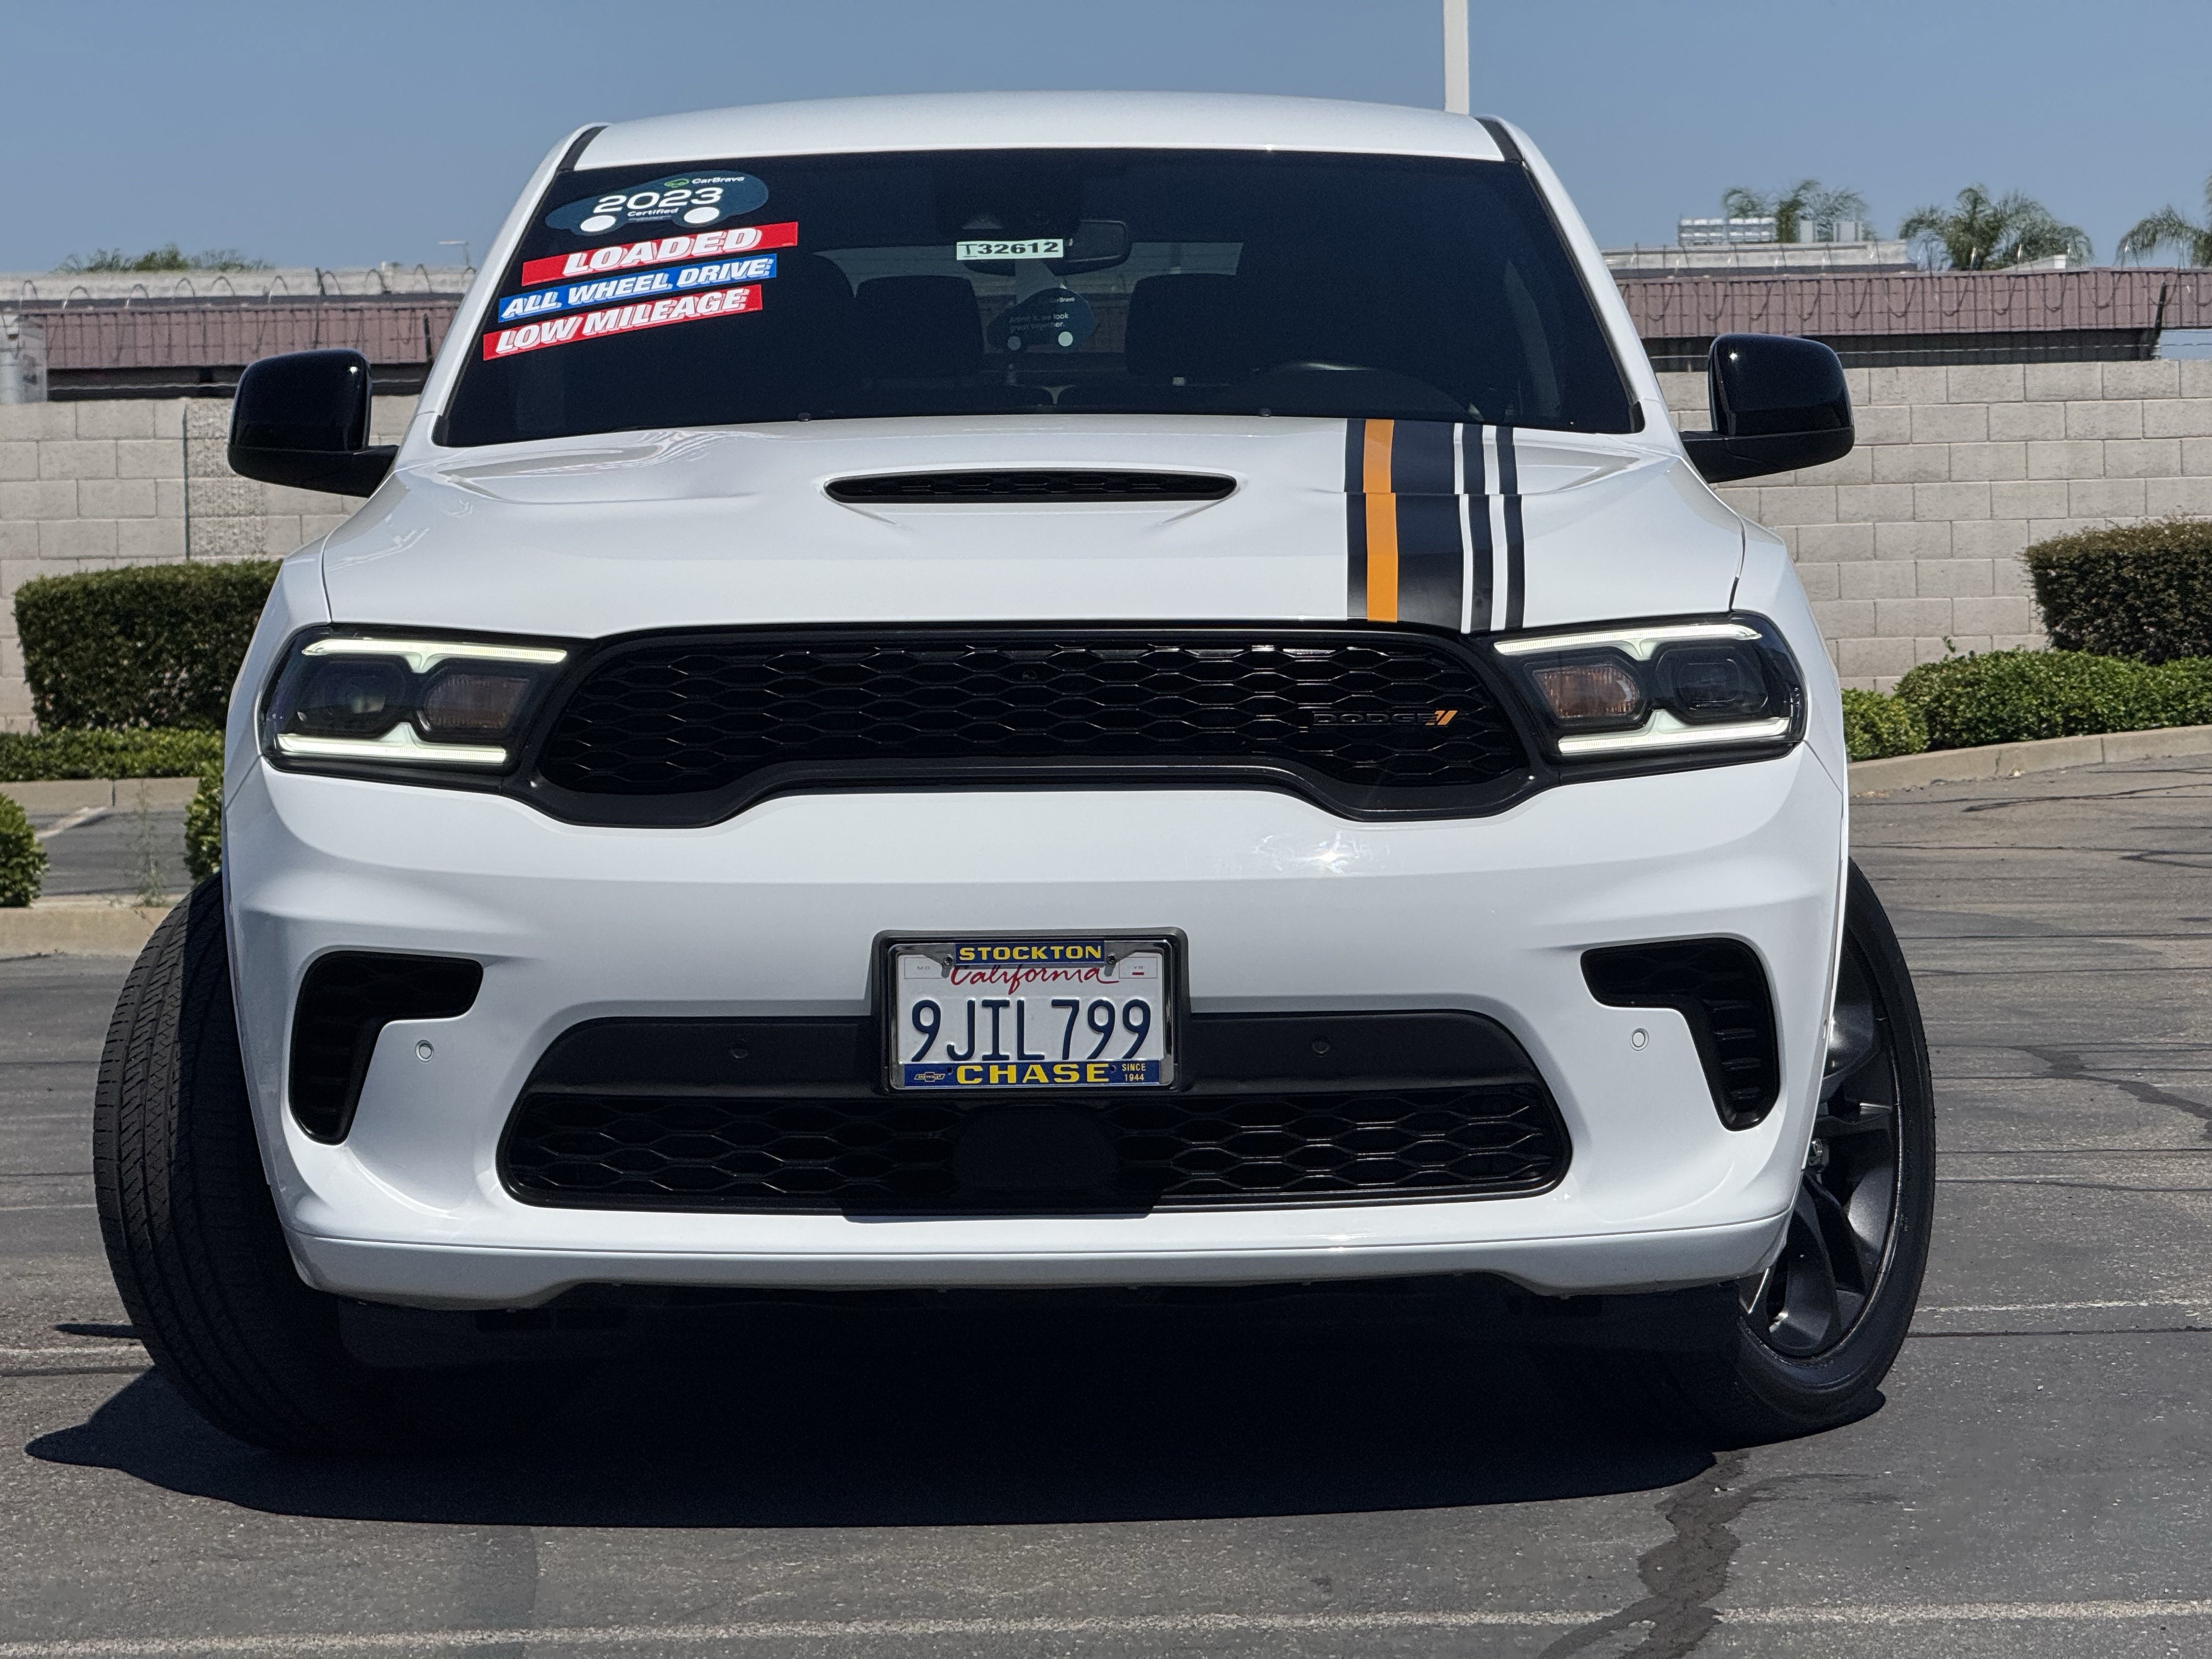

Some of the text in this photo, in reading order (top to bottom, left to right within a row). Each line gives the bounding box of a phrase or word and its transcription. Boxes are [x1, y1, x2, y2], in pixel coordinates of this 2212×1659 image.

[691, 176, 745, 184] CarBravo
[593, 187, 724, 213] 2023
[627, 207, 679, 217] Certified
[563, 228, 762, 276] LOADED
[501, 257, 774, 319] ALL WHEEL DRIVE
[495, 287, 749, 354] LOW MILEAGE
[1053, 312, 1069, 320] look
[1313, 713, 1438, 724] DODGE
[959, 945, 1102, 961] STOCKTON
[950, 964, 1120, 995] California
[911, 998, 1152, 1062] 9JIL799
[956, 1063, 1109, 1085] CHASE
[1121, 1063, 1146, 1071] SINCE
[1124, 1073, 1144, 1081] 1944
